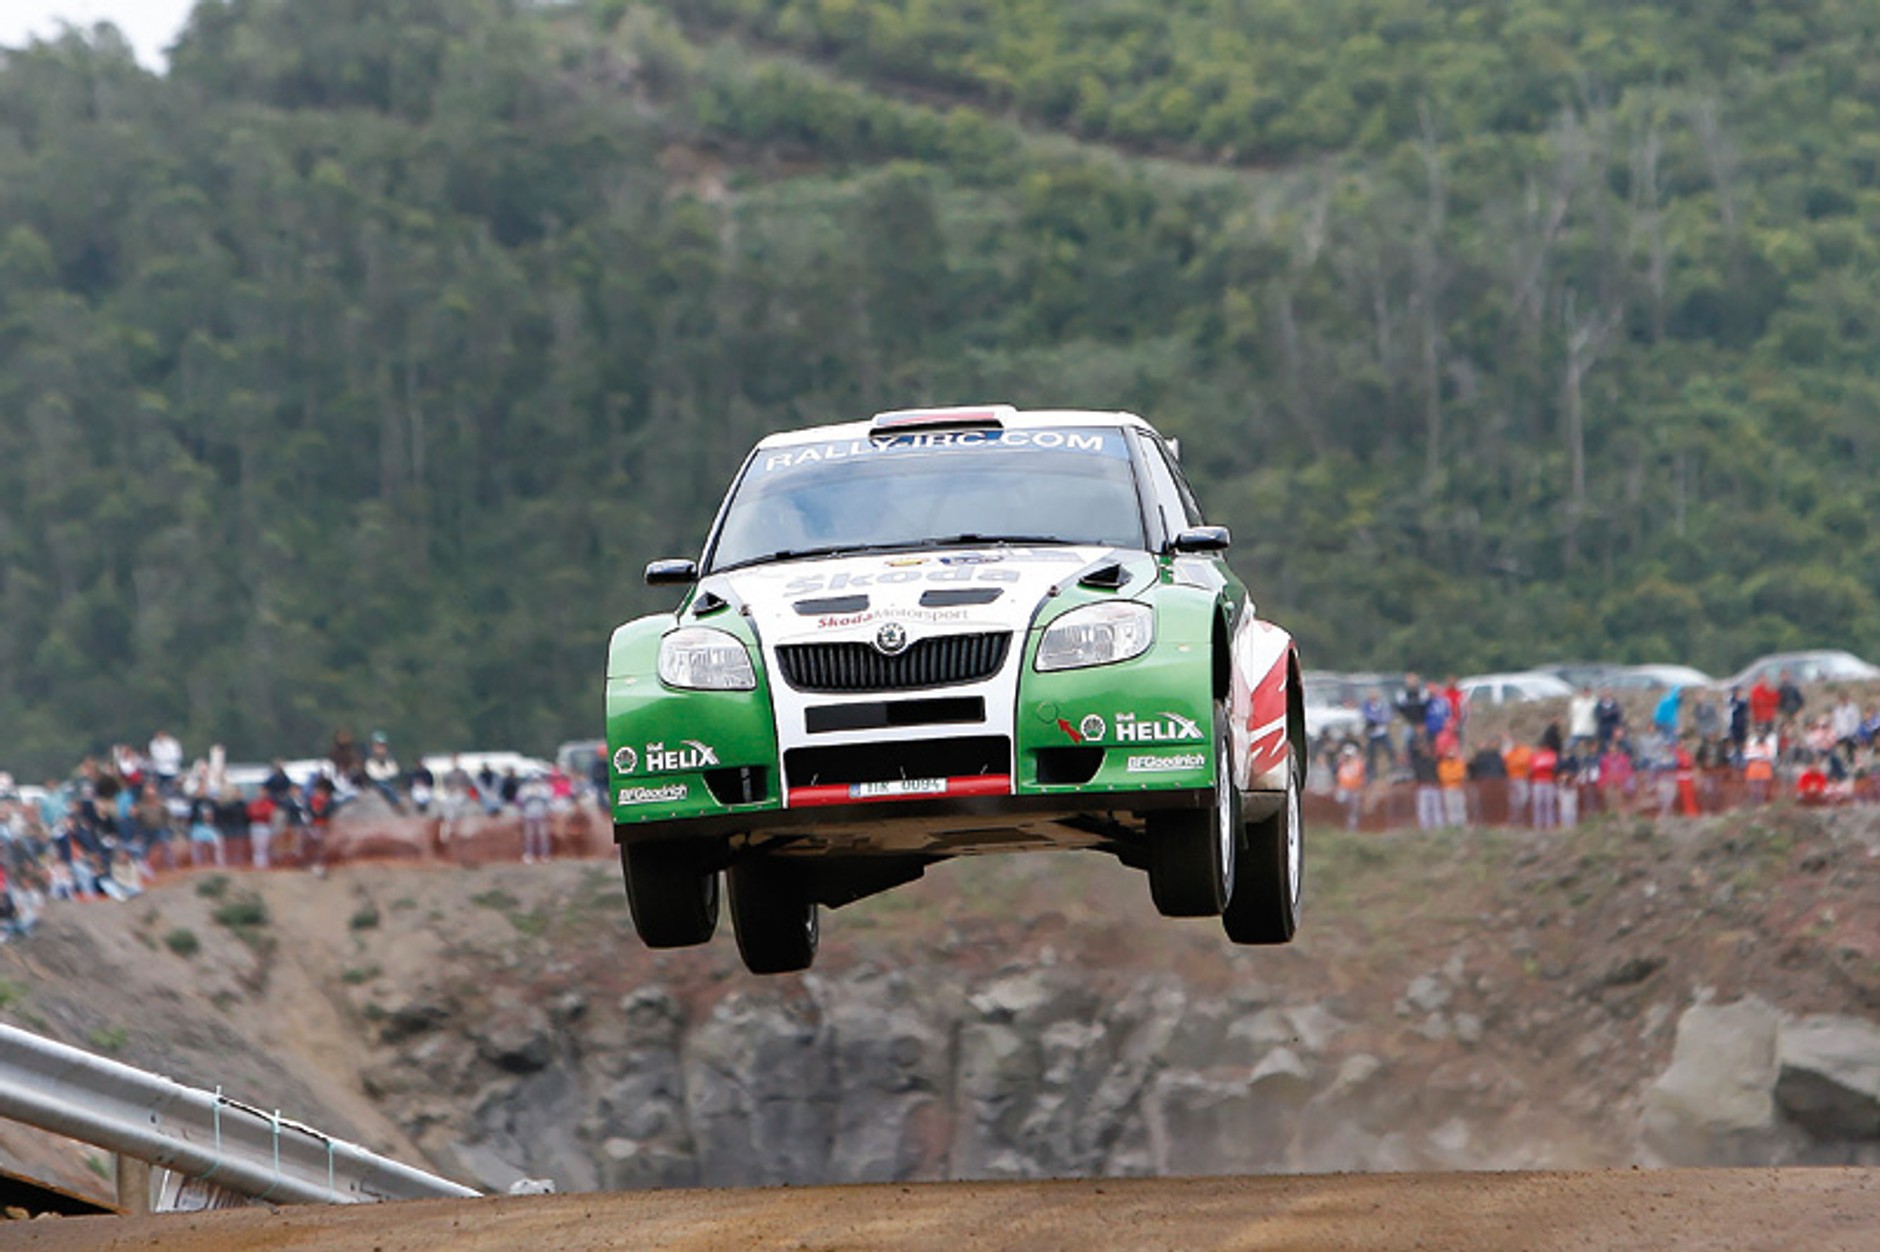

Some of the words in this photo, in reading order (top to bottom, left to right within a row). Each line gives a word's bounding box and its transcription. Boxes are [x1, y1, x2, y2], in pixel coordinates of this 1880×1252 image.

[1115, 712, 1204, 741] HELIX
[645, 741, 720, 772] HELIX
[1127, 753, 1205, 772] BFGoodrich
